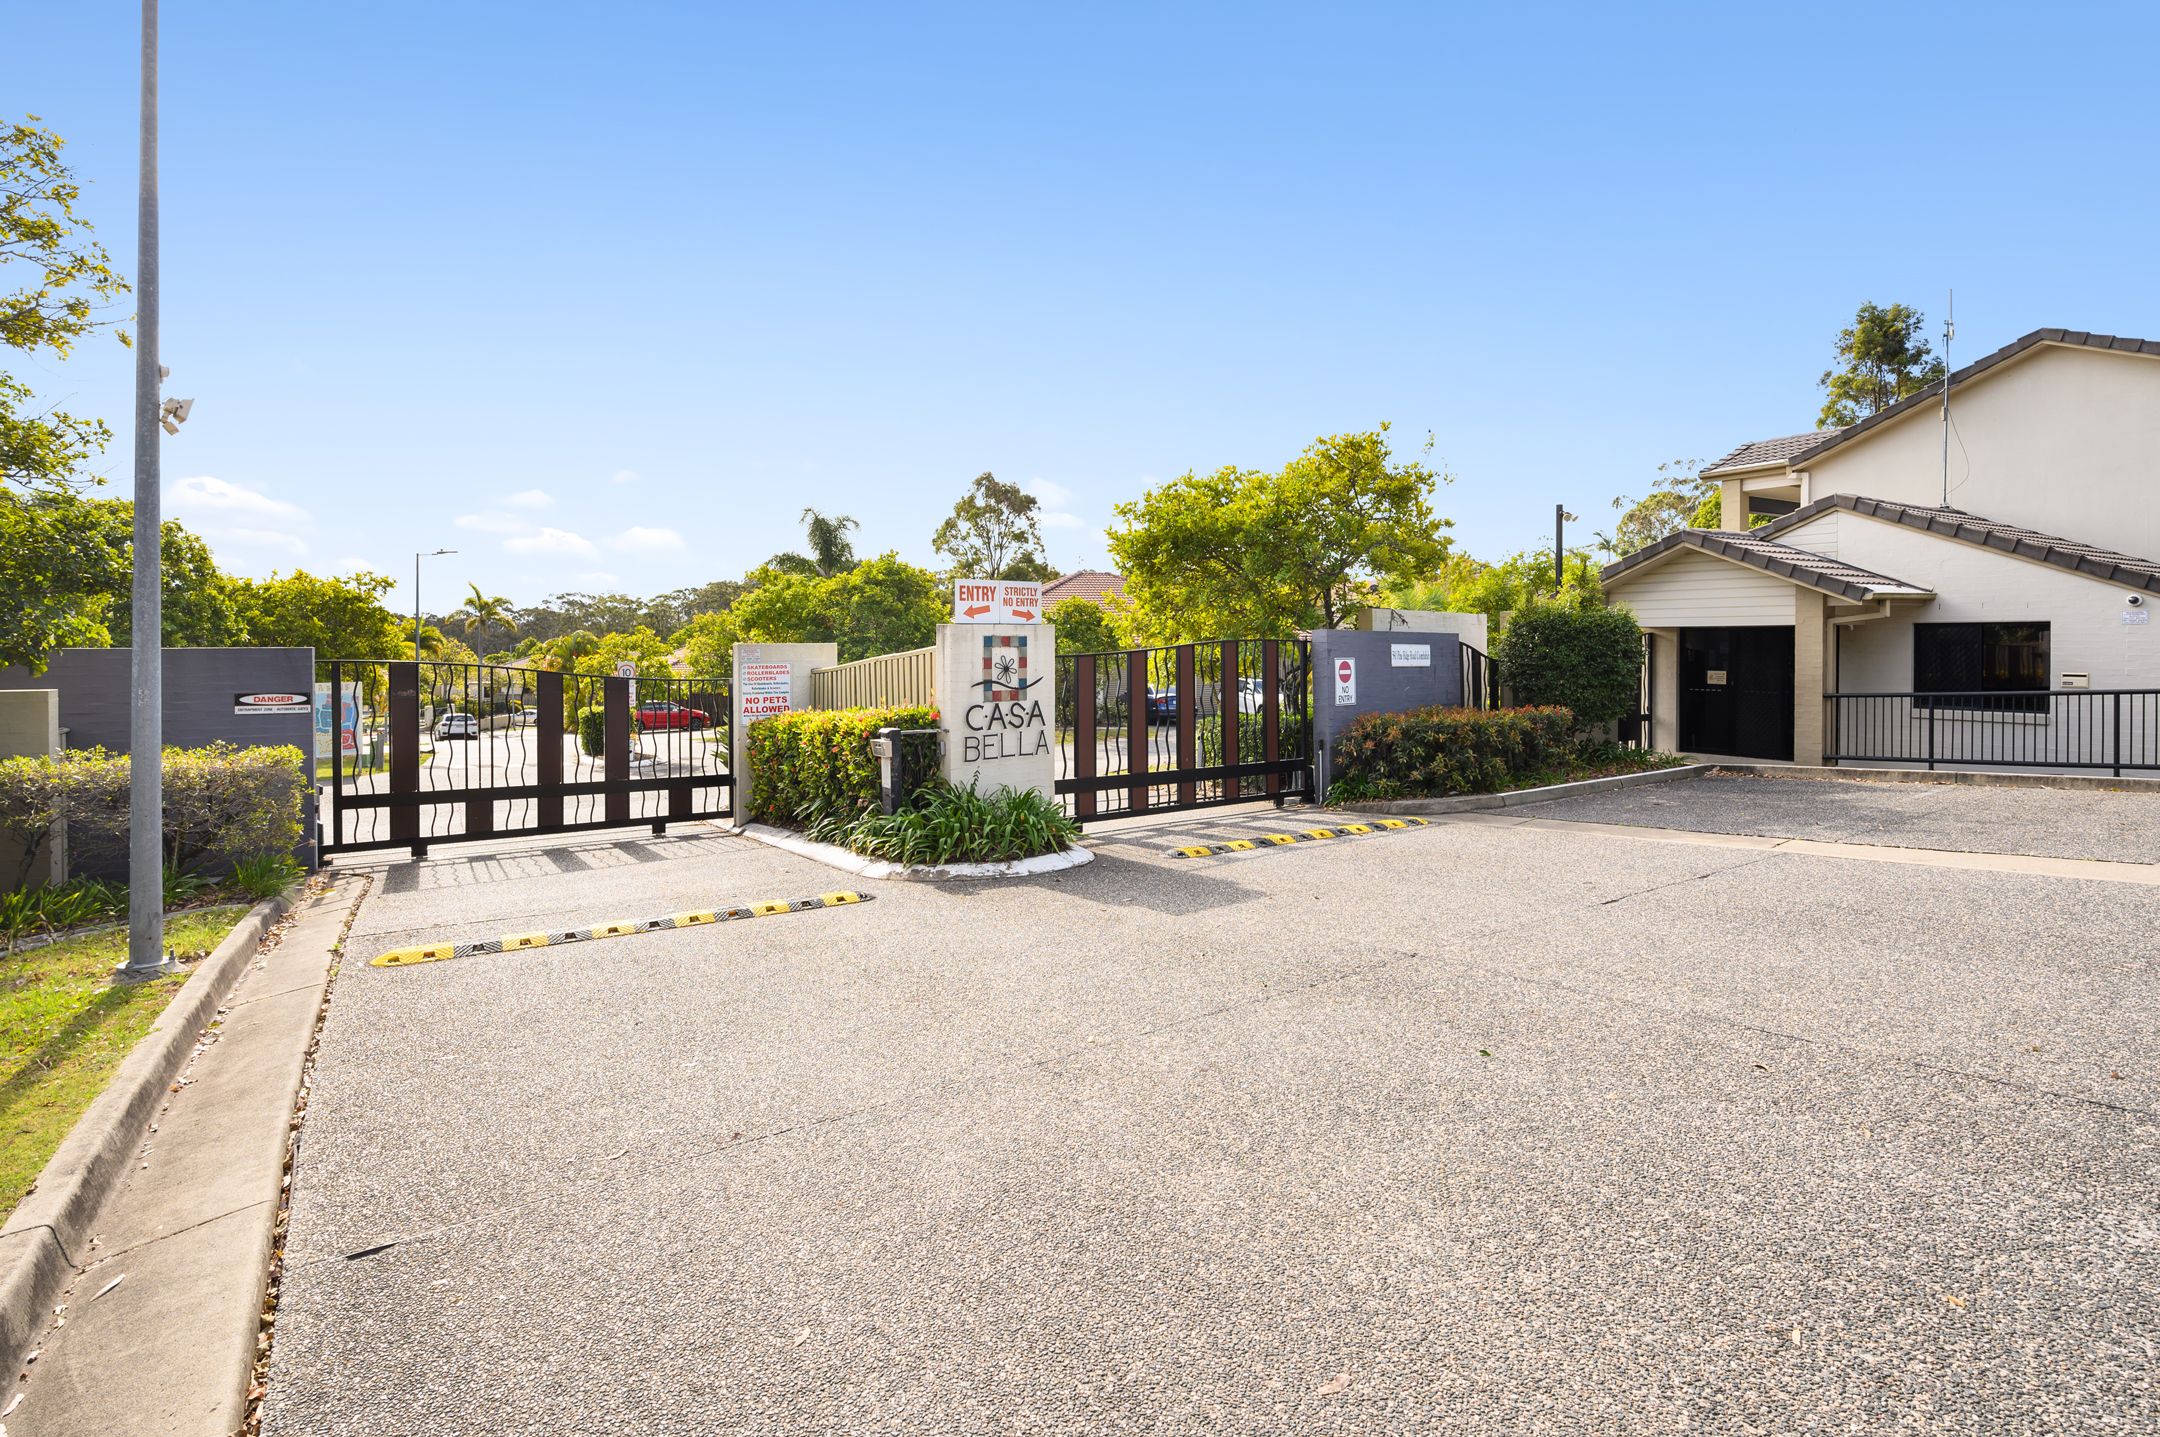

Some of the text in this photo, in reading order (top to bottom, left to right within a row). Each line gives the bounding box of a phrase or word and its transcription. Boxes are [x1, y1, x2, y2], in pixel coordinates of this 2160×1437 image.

[959, 585, 997, 602] ENTRY
[1004, 586, 1038, 597] STRICTLY
[1003, 597, 1039, 607] NO ENTRY
[622, 668, 631, 677] 10
[763, 696, 788, 704] PETS
[1339, 695, 1352, 703] ENTRY
[743, 705, 790, 713] ALLOWED
[963, 729, 1050, 763] BELLA
